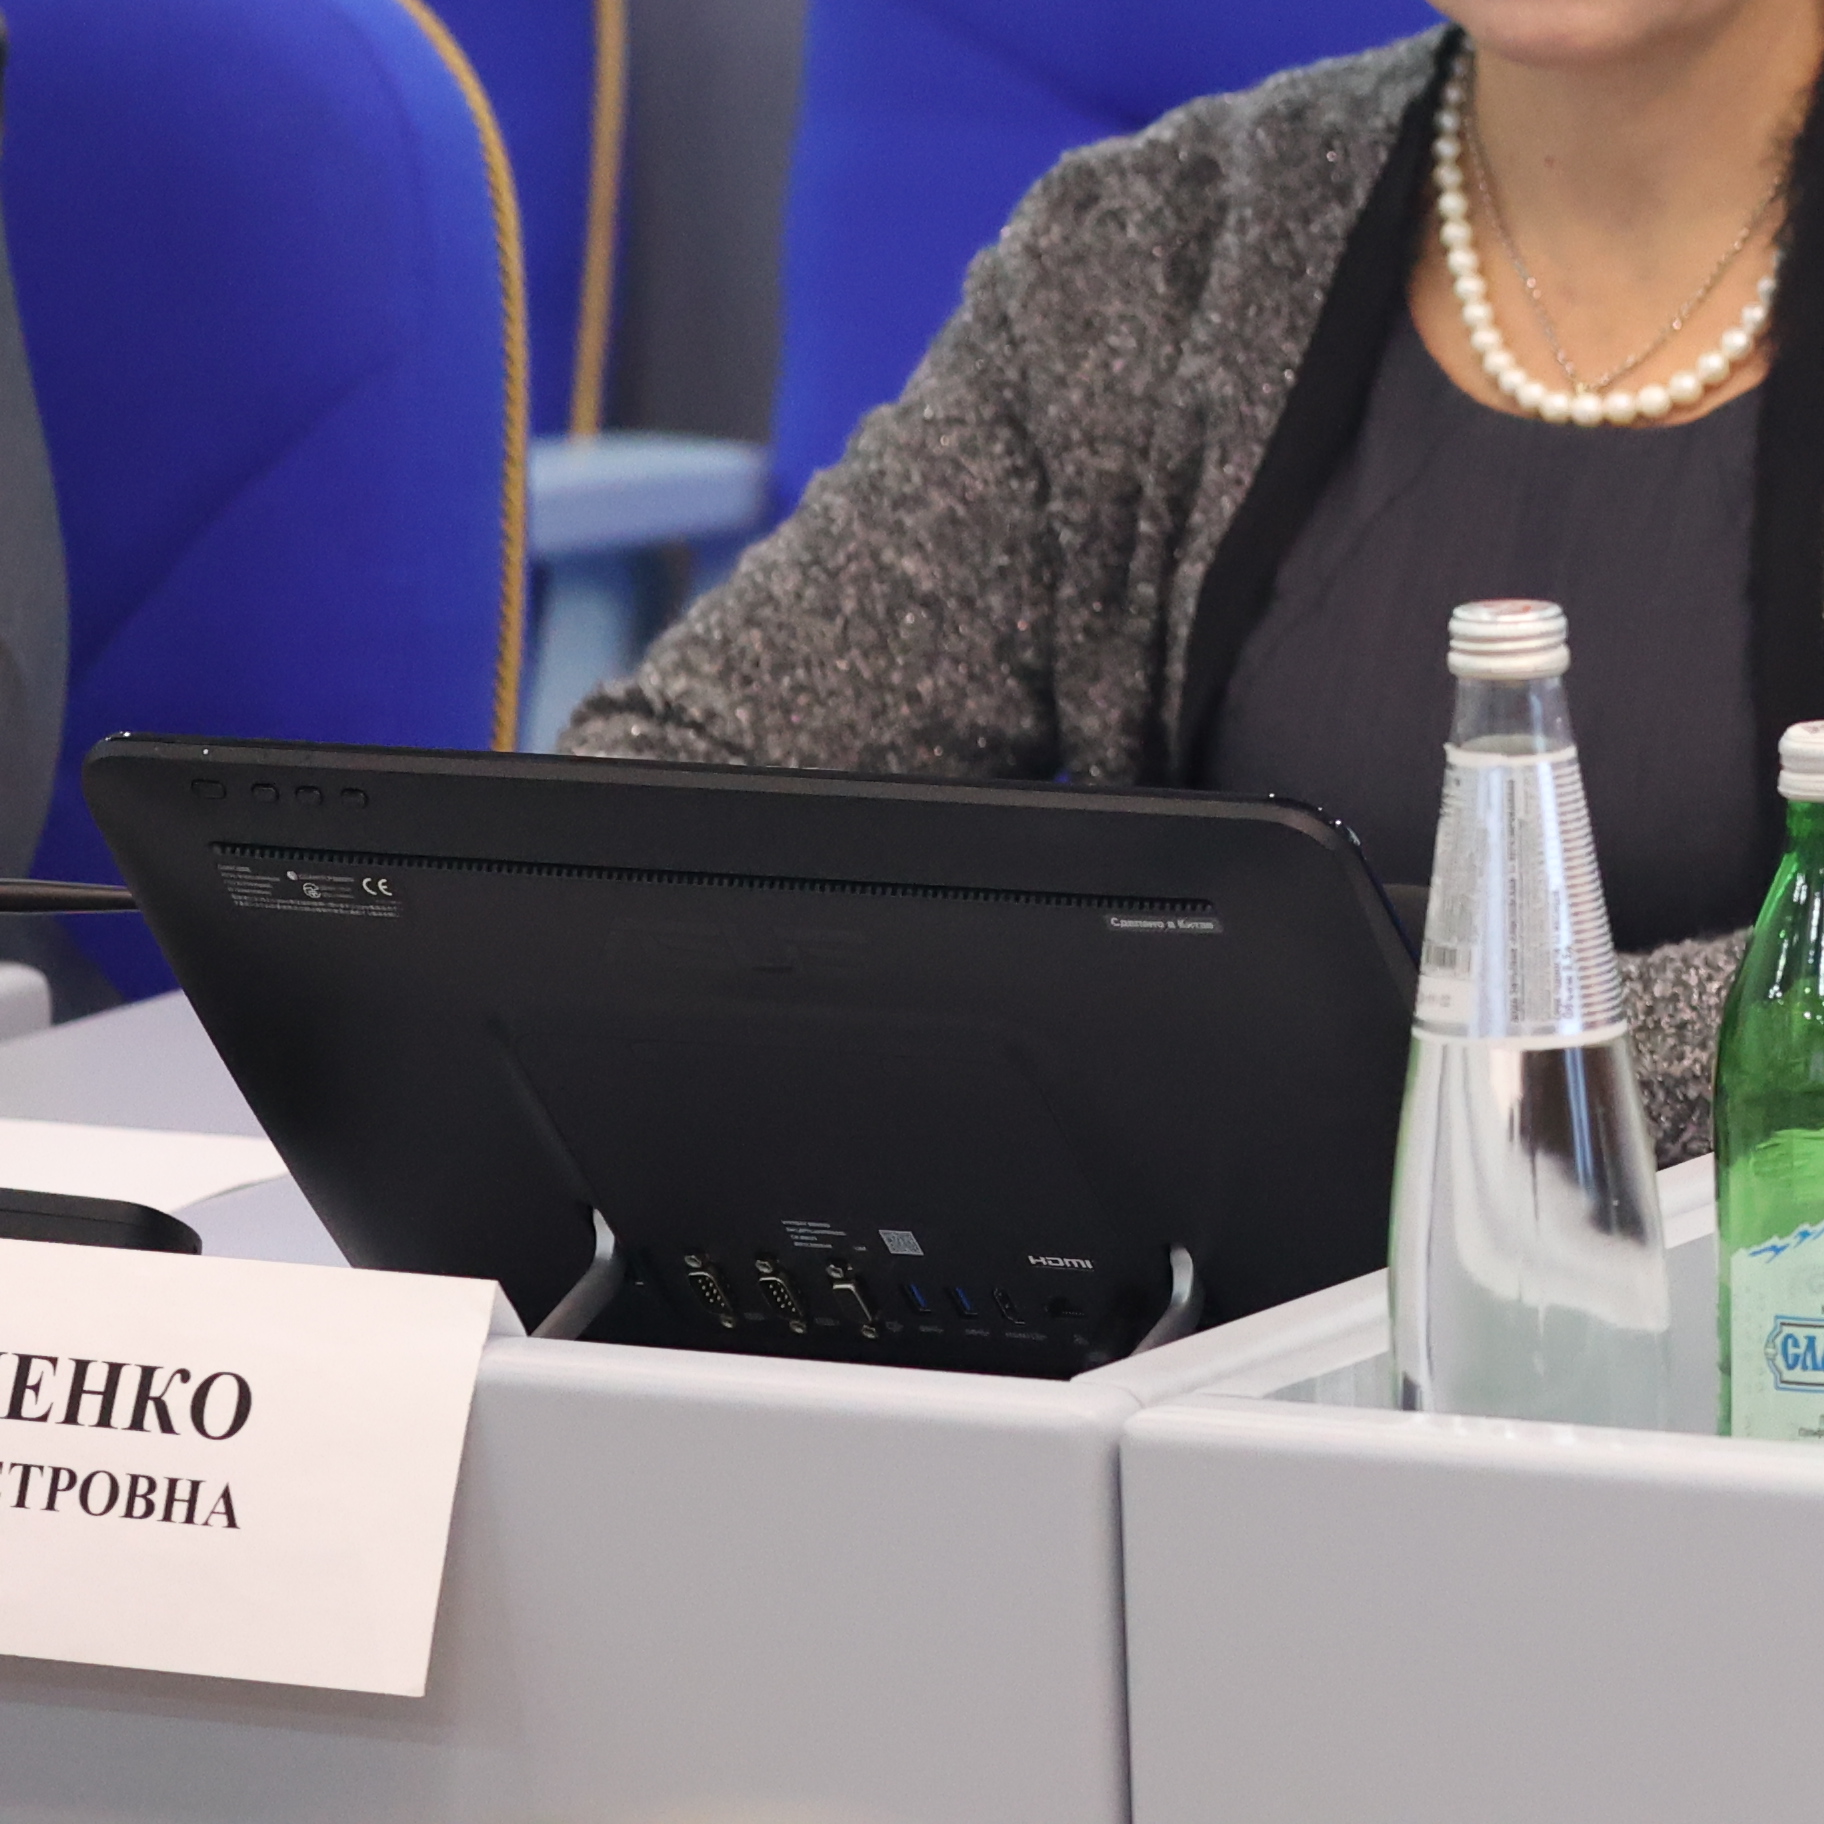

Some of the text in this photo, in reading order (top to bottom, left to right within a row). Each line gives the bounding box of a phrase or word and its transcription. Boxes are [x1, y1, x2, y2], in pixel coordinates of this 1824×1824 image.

[1027, 1254, 1093, 1271] HDMI
[0, 1350, 253, 1441] ЕНКО
[0, 1460, 241, 1530] ТРОВНА
